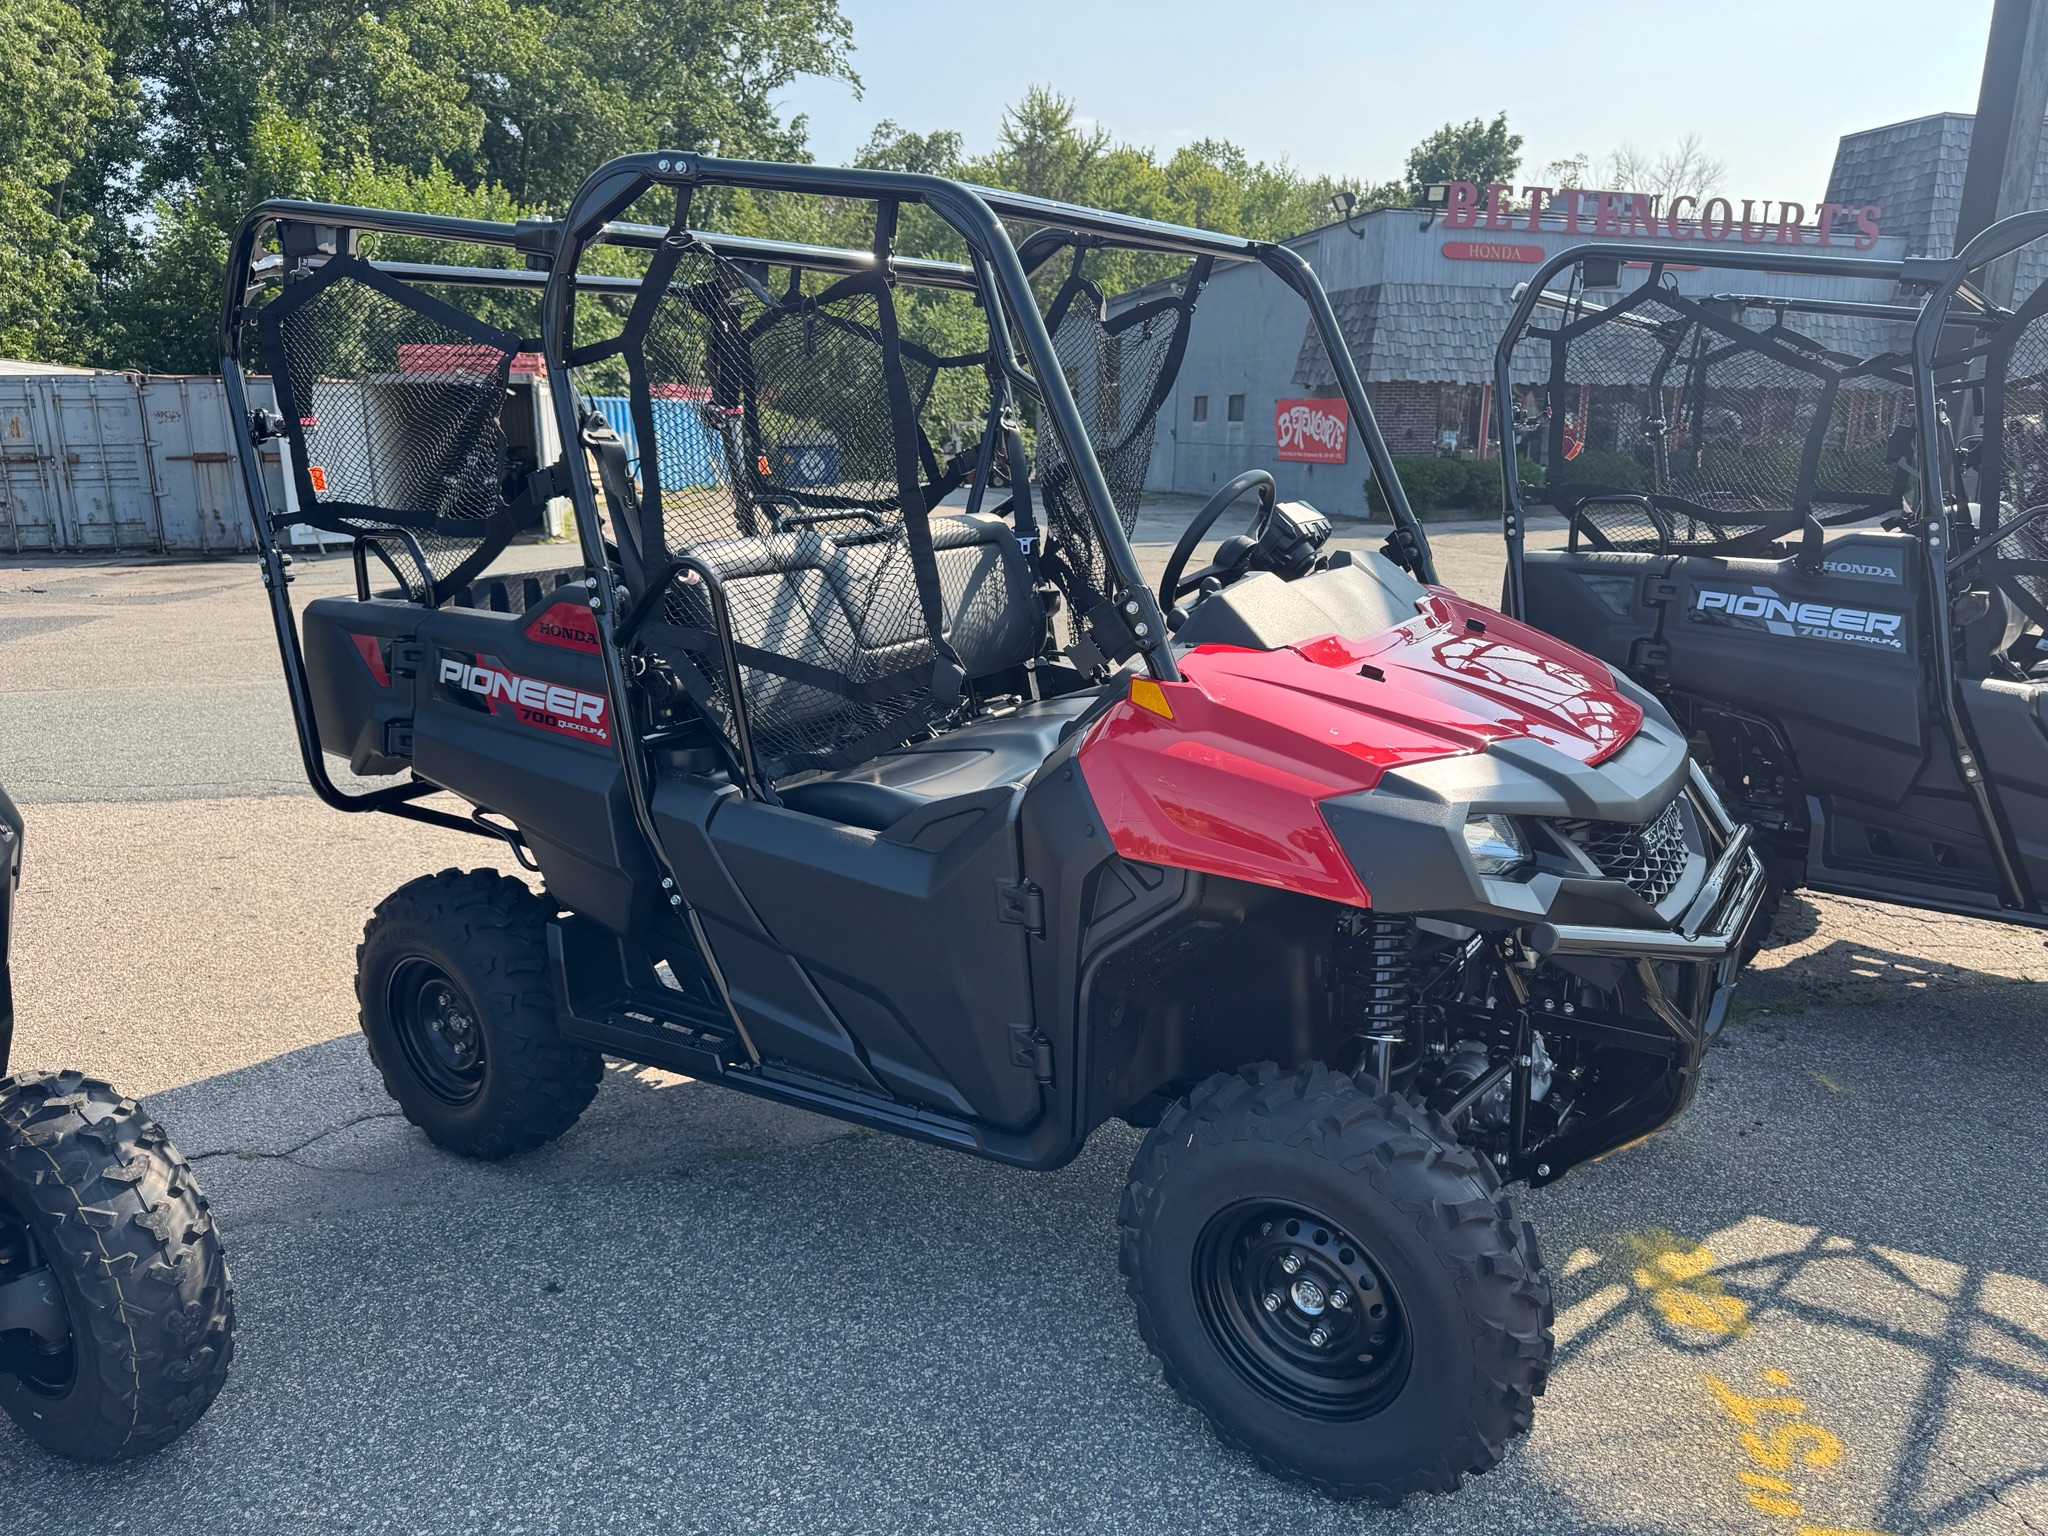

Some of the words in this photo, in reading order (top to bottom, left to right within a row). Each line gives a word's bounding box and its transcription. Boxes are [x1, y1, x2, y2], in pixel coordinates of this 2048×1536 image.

[1444, 180, 1882, 250] BETTENCOURT'S
[1469, 244, 1521, 259] HONDA
[1823, 561, 1896, 577] HONDA
[1697, 590, 1901, 636] PIONEER
[539, 622, 599, 645] HONDA
[1798, 626, 1844, 640] 700
[439, 658, 604, 723] PIONEER
[520, 708, 557, 727] 700
